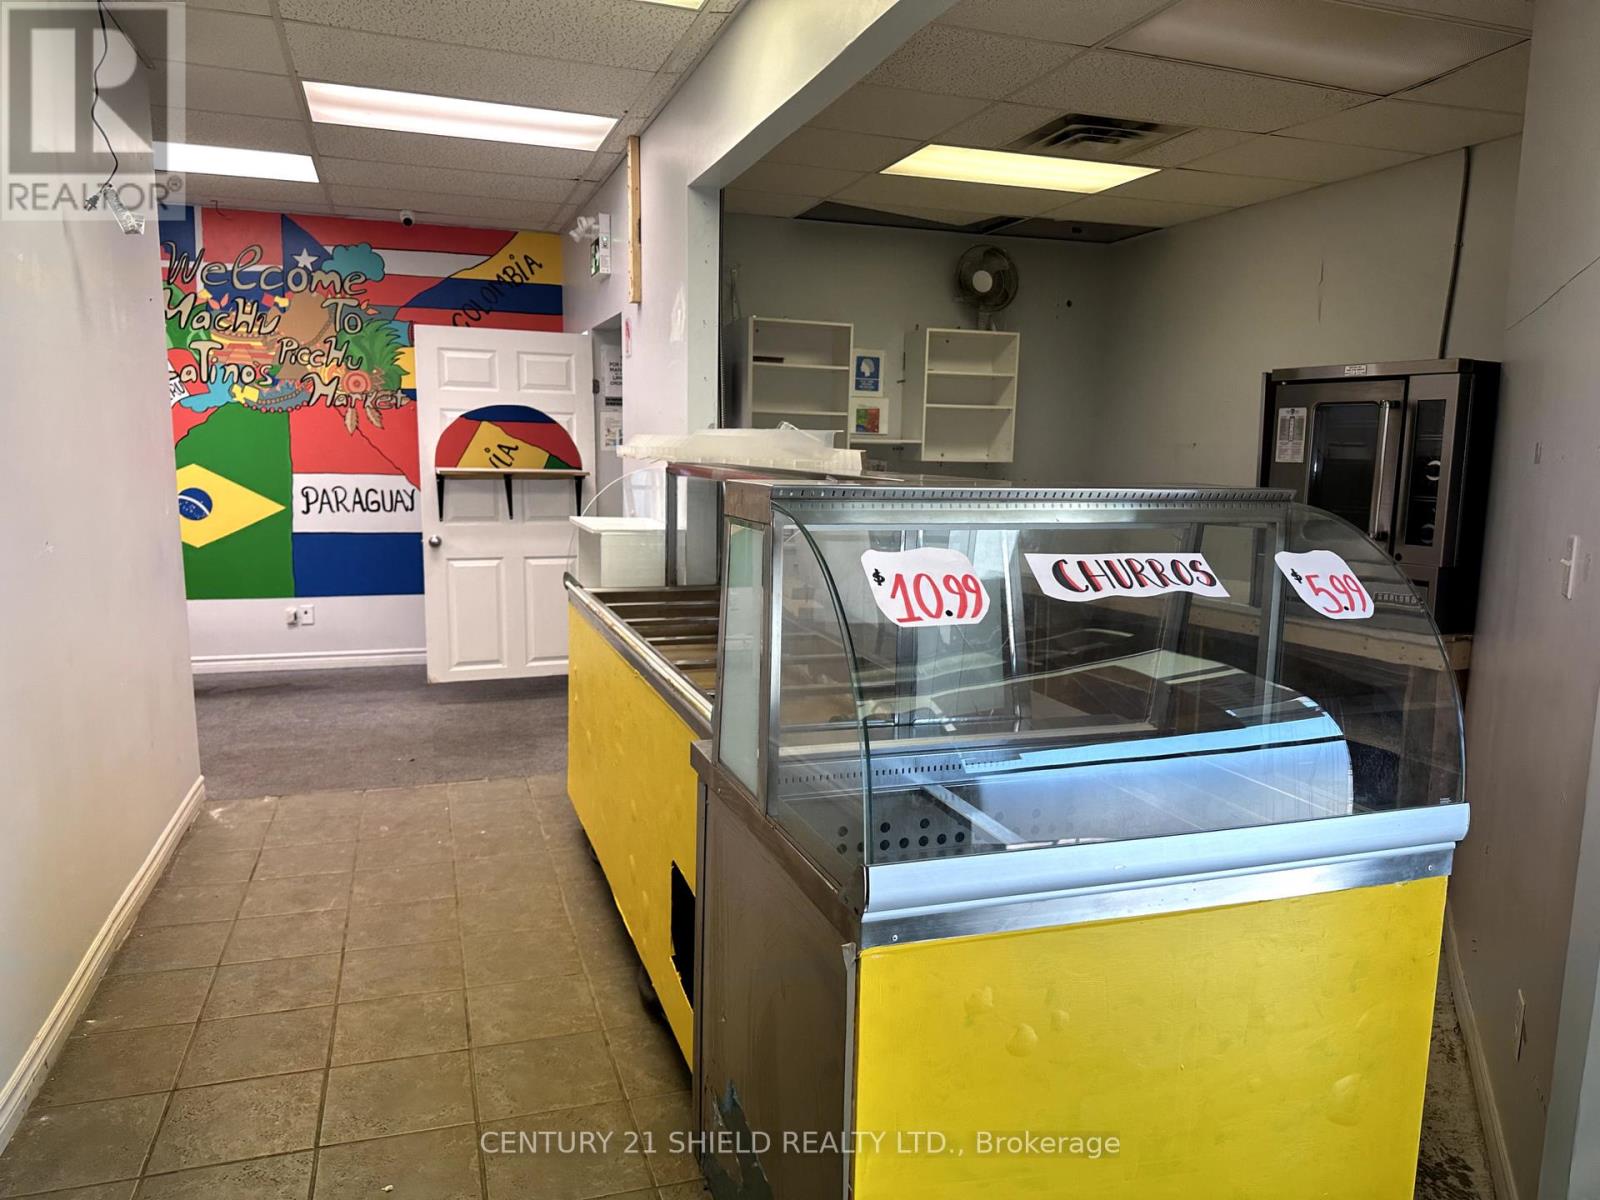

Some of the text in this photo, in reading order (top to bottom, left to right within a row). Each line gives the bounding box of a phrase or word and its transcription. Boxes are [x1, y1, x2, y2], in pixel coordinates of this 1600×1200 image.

[161, 241, 367, 296] Welcome
[321, 297, 363, 335] To
[301, 486, 416, 514] PARAGUAY
[1052, 558, 1217, 593] CHURROS
